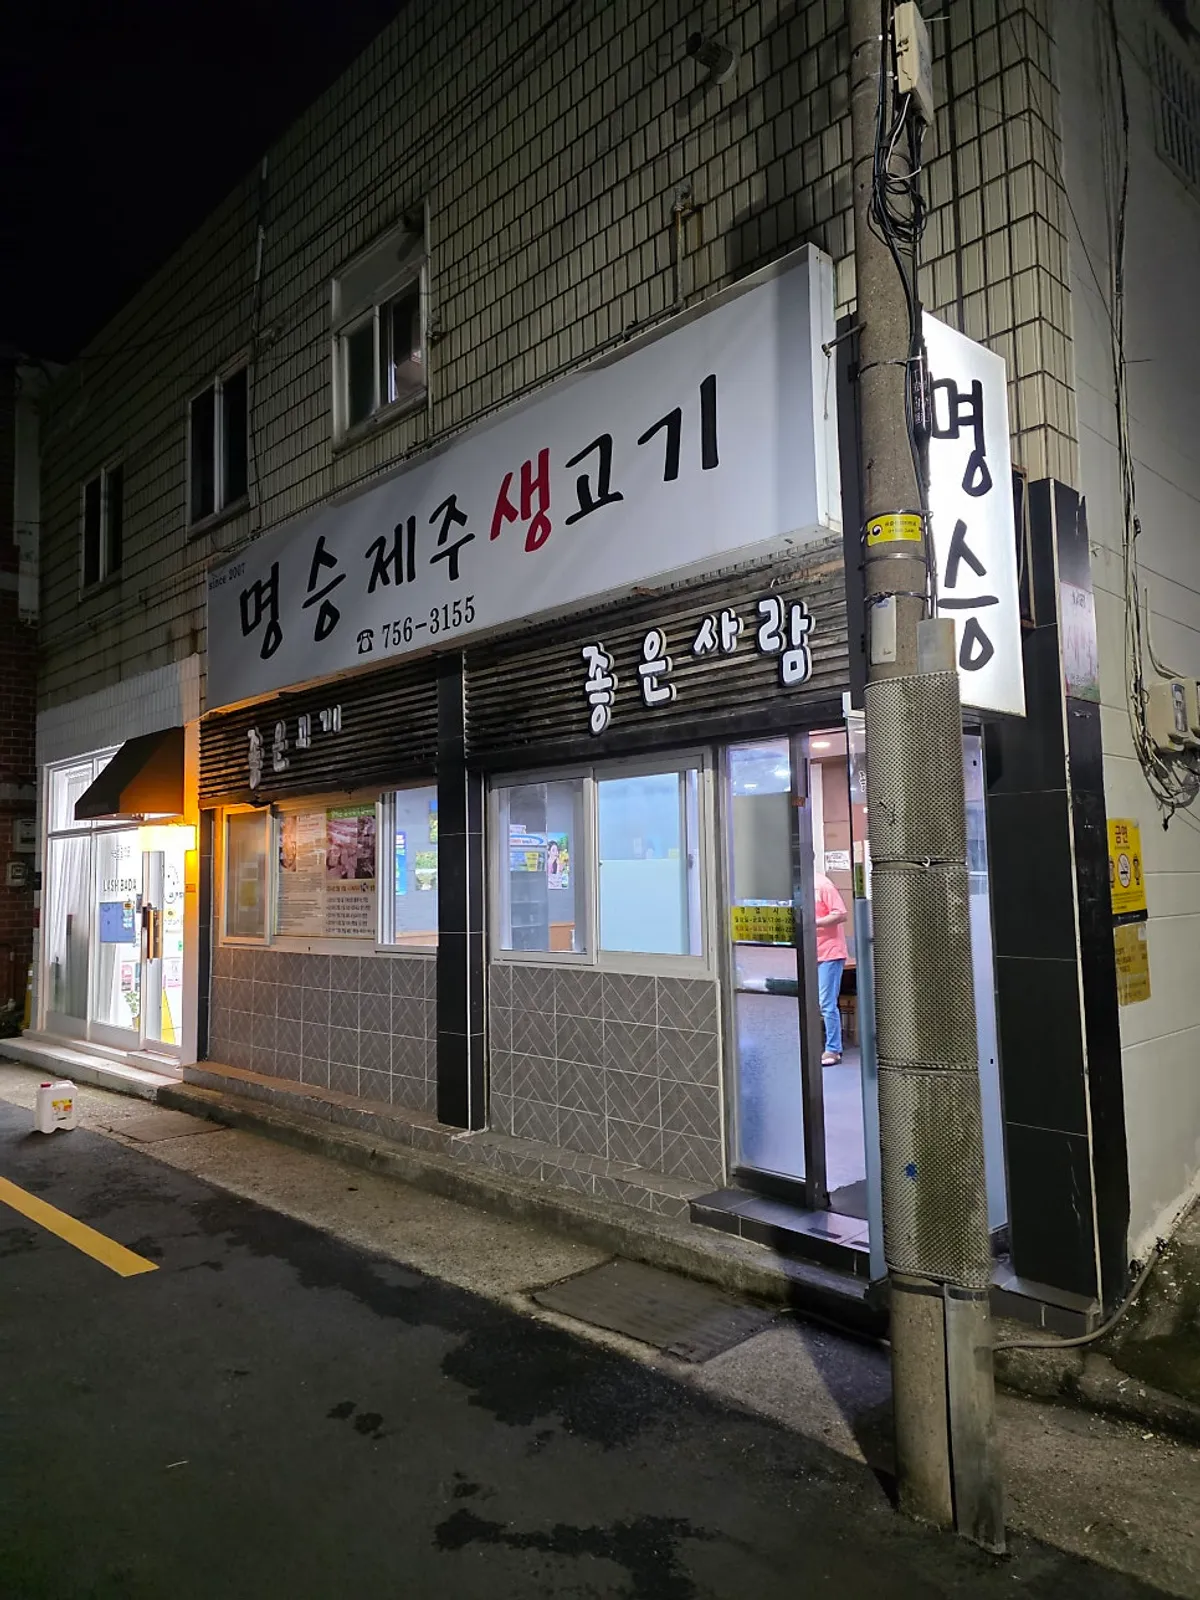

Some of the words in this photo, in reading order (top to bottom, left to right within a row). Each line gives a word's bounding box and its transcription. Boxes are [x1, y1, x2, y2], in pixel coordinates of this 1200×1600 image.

[208, 576, 226, 590] since
[229, 562, 246, 581] 2007
[382, 595, 475, 649] 756-3155
